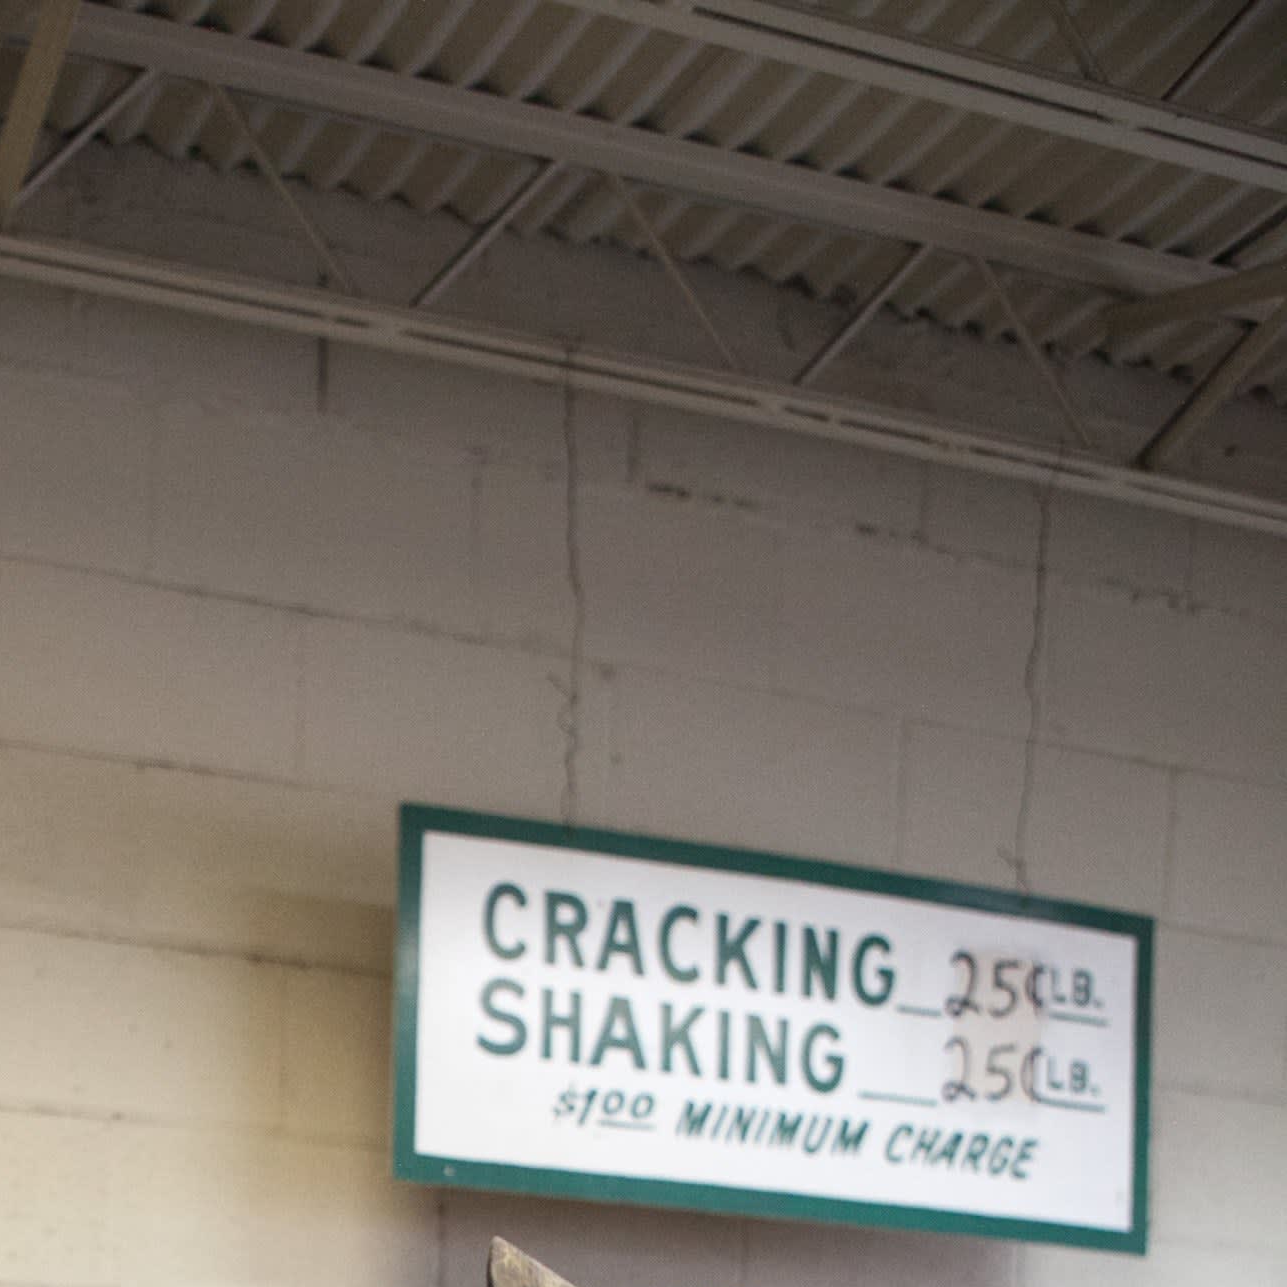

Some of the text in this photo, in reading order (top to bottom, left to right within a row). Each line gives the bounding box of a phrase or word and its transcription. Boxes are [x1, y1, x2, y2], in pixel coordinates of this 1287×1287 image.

[483, 882, 896, 1007] CRACKING
[476, 977, 845, 1094] SHAKING
[675, 1098, 870, 1155] MINIMUM
[885, 1122, 1038, 1180] CHARGE
